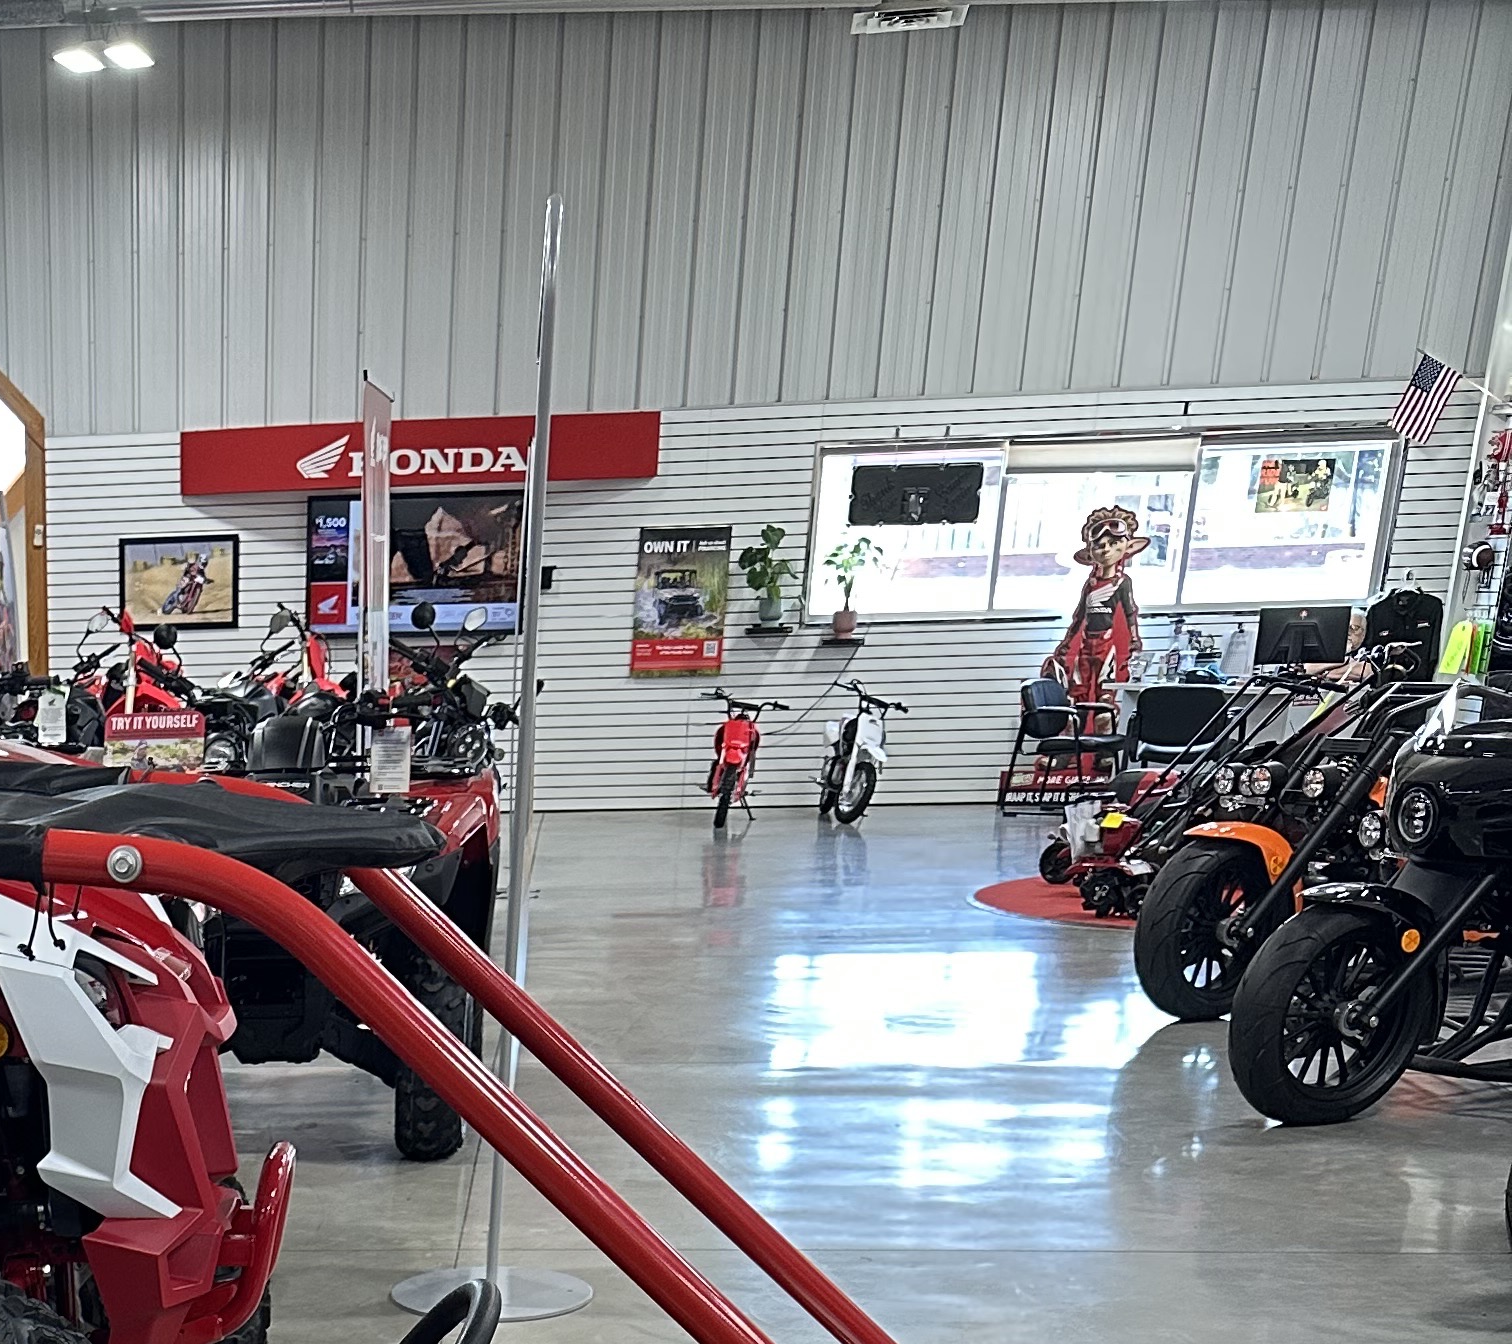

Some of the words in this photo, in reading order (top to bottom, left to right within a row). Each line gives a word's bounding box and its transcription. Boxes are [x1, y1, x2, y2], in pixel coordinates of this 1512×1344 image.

[643, 541, 675, 553] OWN
[676, 540, 690, 553] IT
[111, 717, 132, 731] TRY
[132, 716, 144, 730] IT
[145, 714, 199, 729] YOURSELF
